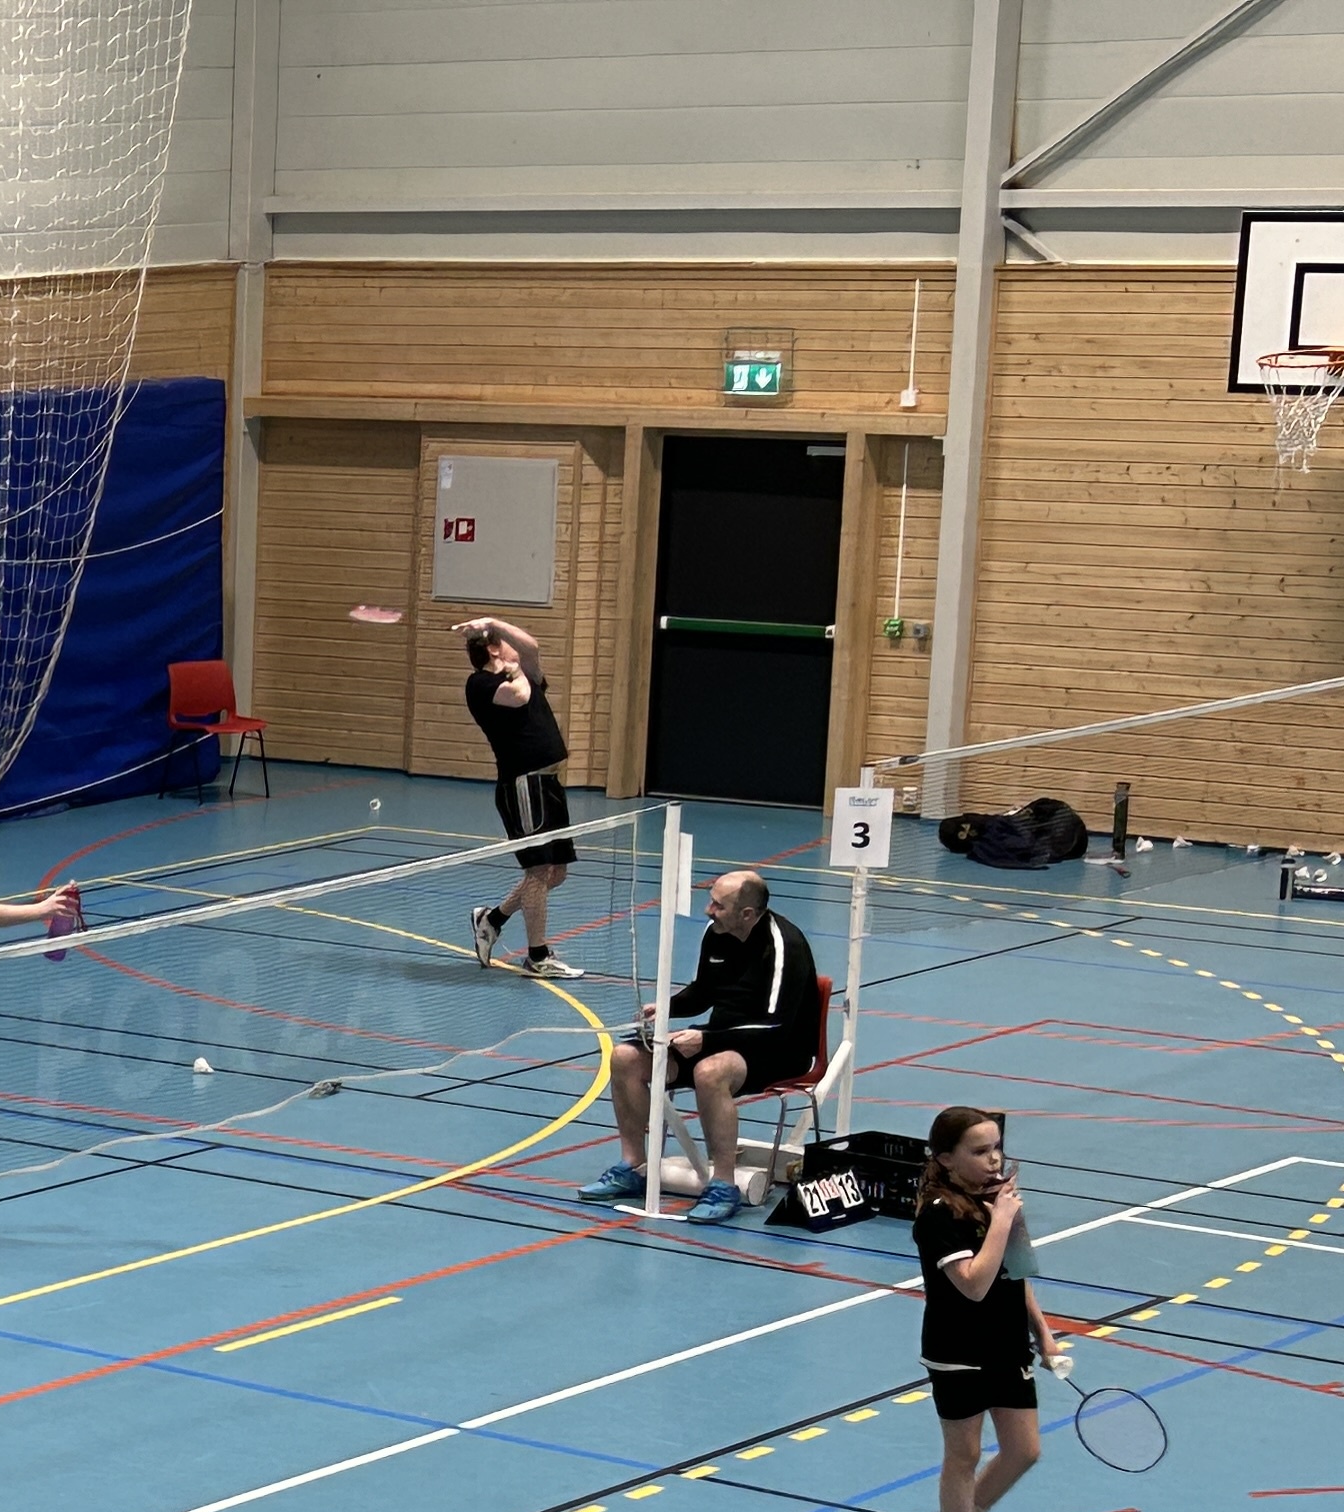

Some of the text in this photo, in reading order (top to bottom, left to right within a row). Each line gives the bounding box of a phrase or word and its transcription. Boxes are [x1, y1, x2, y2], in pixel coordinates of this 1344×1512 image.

[851, 822, 871, 848] 3
[802, 1185, 827, 1215] 21
[838, 1173, 862, 1205] 13
